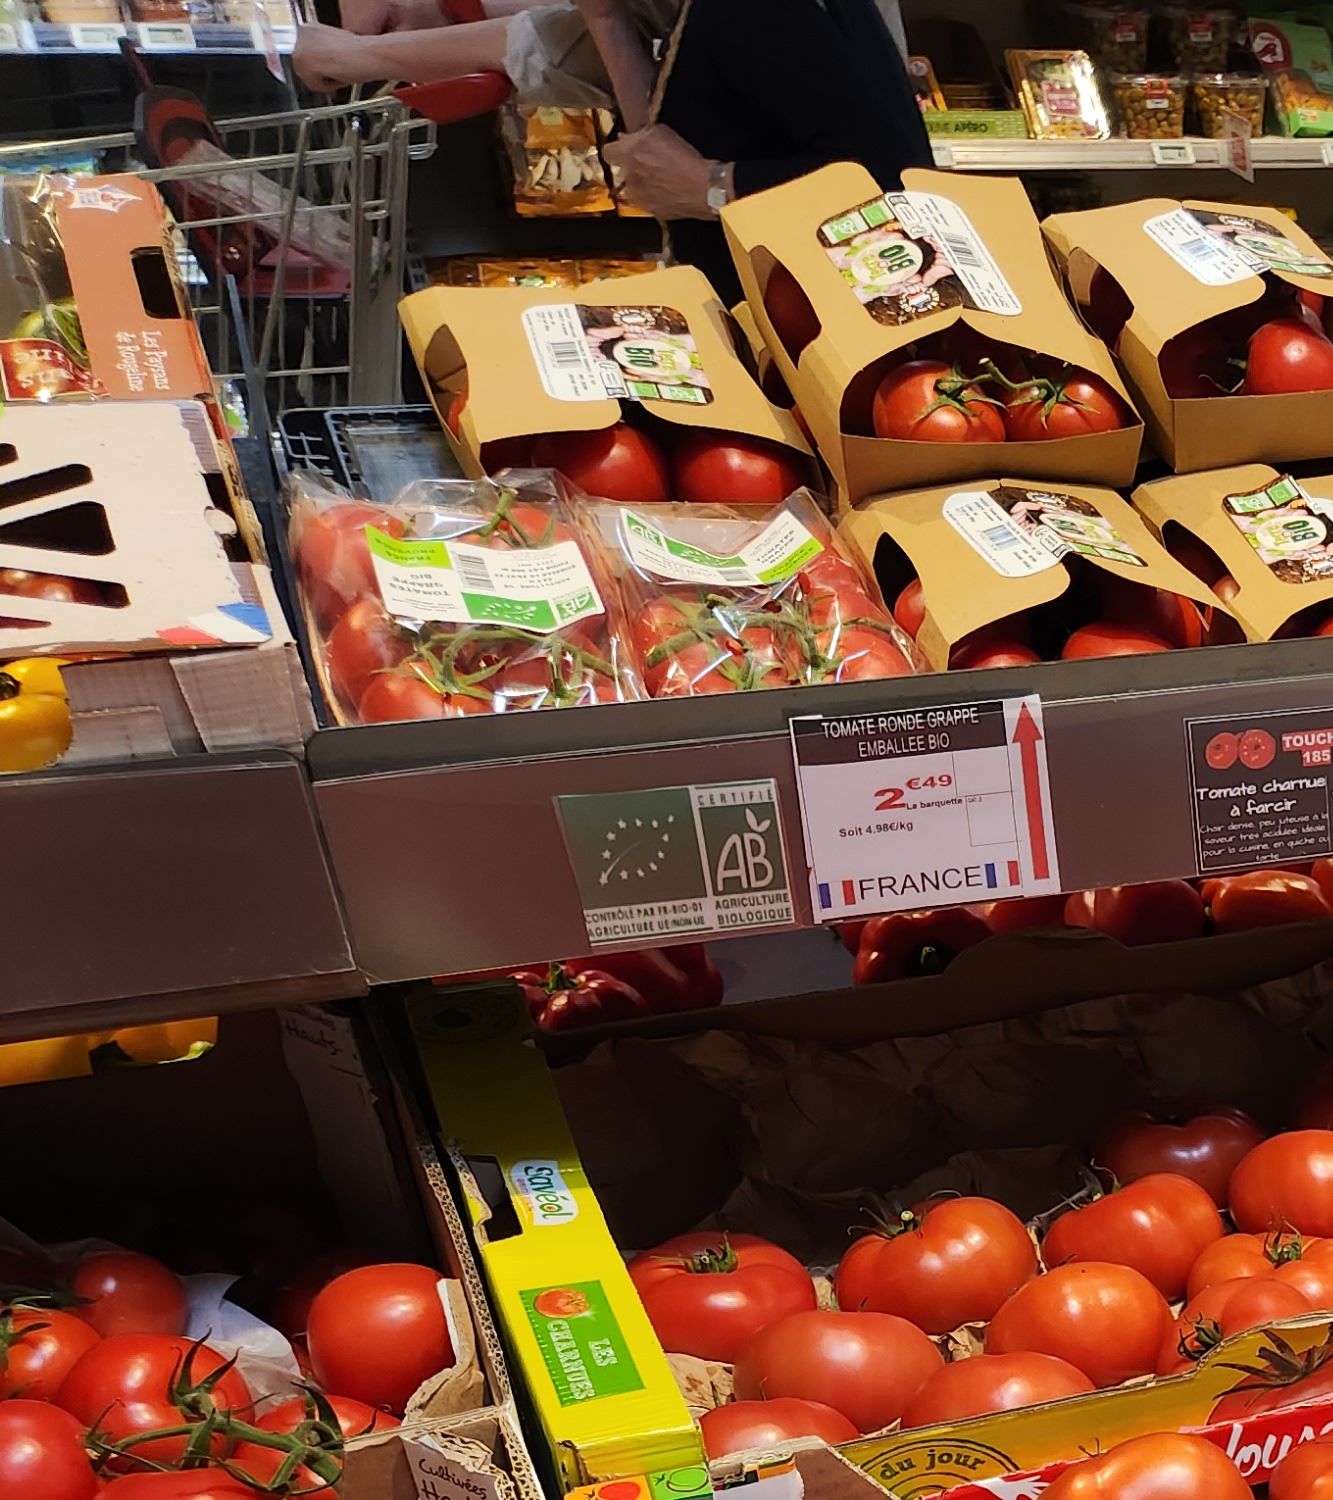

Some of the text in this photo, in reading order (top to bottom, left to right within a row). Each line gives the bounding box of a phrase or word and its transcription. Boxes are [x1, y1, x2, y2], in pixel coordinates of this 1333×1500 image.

[878, 244, 917, 275] BIO
[116, 331, 148, 392] de Rougeline
[142, 331, 171, 390] Les Paysans
[624, 346, 659, 367] BIO
[1282, 519, 1320, 543] BIO
[389, 583, 450, 596] TOMATES
[392, 577, 443, 588] GRAPPE
[821, 708, 980, 738] TOMATE RONDE GRAPPE
[858, 733, 950, 758] EMBALLEE BIO
[1303, 751, 1331, 764] 185
[697, 788, 774, 806] CERTIFIÉ
[874, 774, 953, 811] 2 €49
[1196, 777, 1326, 801] Tomate charnue
[906, 797, 963, 810] La barquette
[1230, 799, 1297, 817] à farcir
[838, 821, 914, 838] Soit 4.98€/kg
[1200, 824, 1225, 834] Chair
[1259, 820, 1276, 831] peu
[1278, 815, 1309, 831] juteuse
[1203, 849, 1225, 861] pour
[1288, 836, 1315, 850] quiche
[1204, 836, 1236, 845] saveur
[716, 832, 774, 892] AB
[1256, 853, 1280, 862] tarte
[858, 865, 983, 900] FRANCE
[637, 905, 655, 918] PAR
[715, 893, 790, 911] AGRICULTURE
[718, 907, 792, 925] BIOLOGIQUE
[588, 922, 654, 938] AGRICULTURE
[523, 1166, 575, 1220] Savéol
[547, 1319, 596, 1401] CHARNUES
[588, 1338, 618, 1367] LES
[879, 1446, 986, 1484] du jour
[418, 1457, 489, 1500] Cultivées
